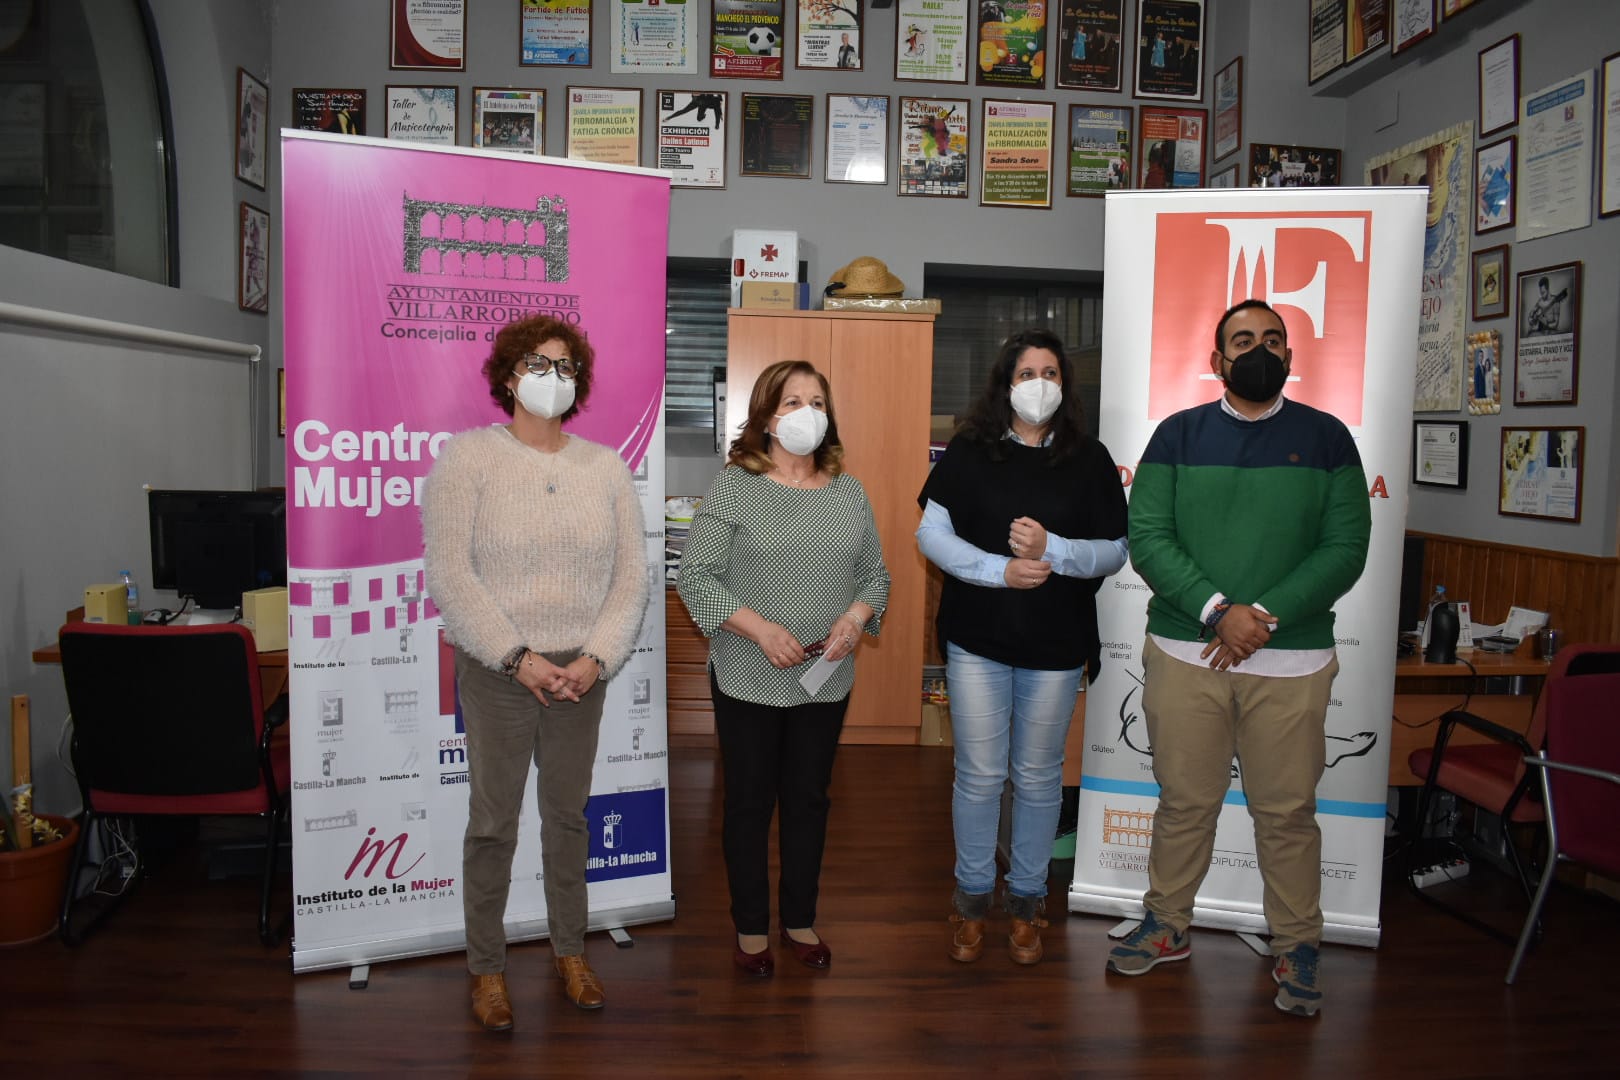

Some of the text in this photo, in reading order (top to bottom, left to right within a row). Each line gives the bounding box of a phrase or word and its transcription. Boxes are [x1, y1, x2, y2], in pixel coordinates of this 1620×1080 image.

[392, 98, 417, 109] Taller
[573, 116, 627, 125] FIBROMIALGIA
[391, 121, 454, 134] Musicoterapia
[988, 128, 1047, 137] ACTUALIZACIÓN
[387, 286, 580, 308] AYUNTAMIENTO DE
[1422, 296, 1441, 320] EJO
[371, 656, 413, 666] Castilla-La
[1110, 652, 1131, 660] lateral
[294, 662, 325, 670] Instituto
[317, 728, 343, 738] mujer
[439, 738, 467, 749] cent
[1091, 744, 1115, 754] Glúteo
[608, 750, 667, 764] Castilla-La Mancha
[294, 776, 366, 791] Castilla-La Mancha
[620, 850, 657, 866] Mancha
[1099, 851, 1150, 862] AYUNTAMIE
[1099, 860, 1148, 871] VILLARRO
[1210, 856, 1357, 880] DIPUTAC ACETE
[296, 877, 454, 906] Instituto de la Mujer
[296, 890, 455, 916] CASTILLA-LA MANCHA
